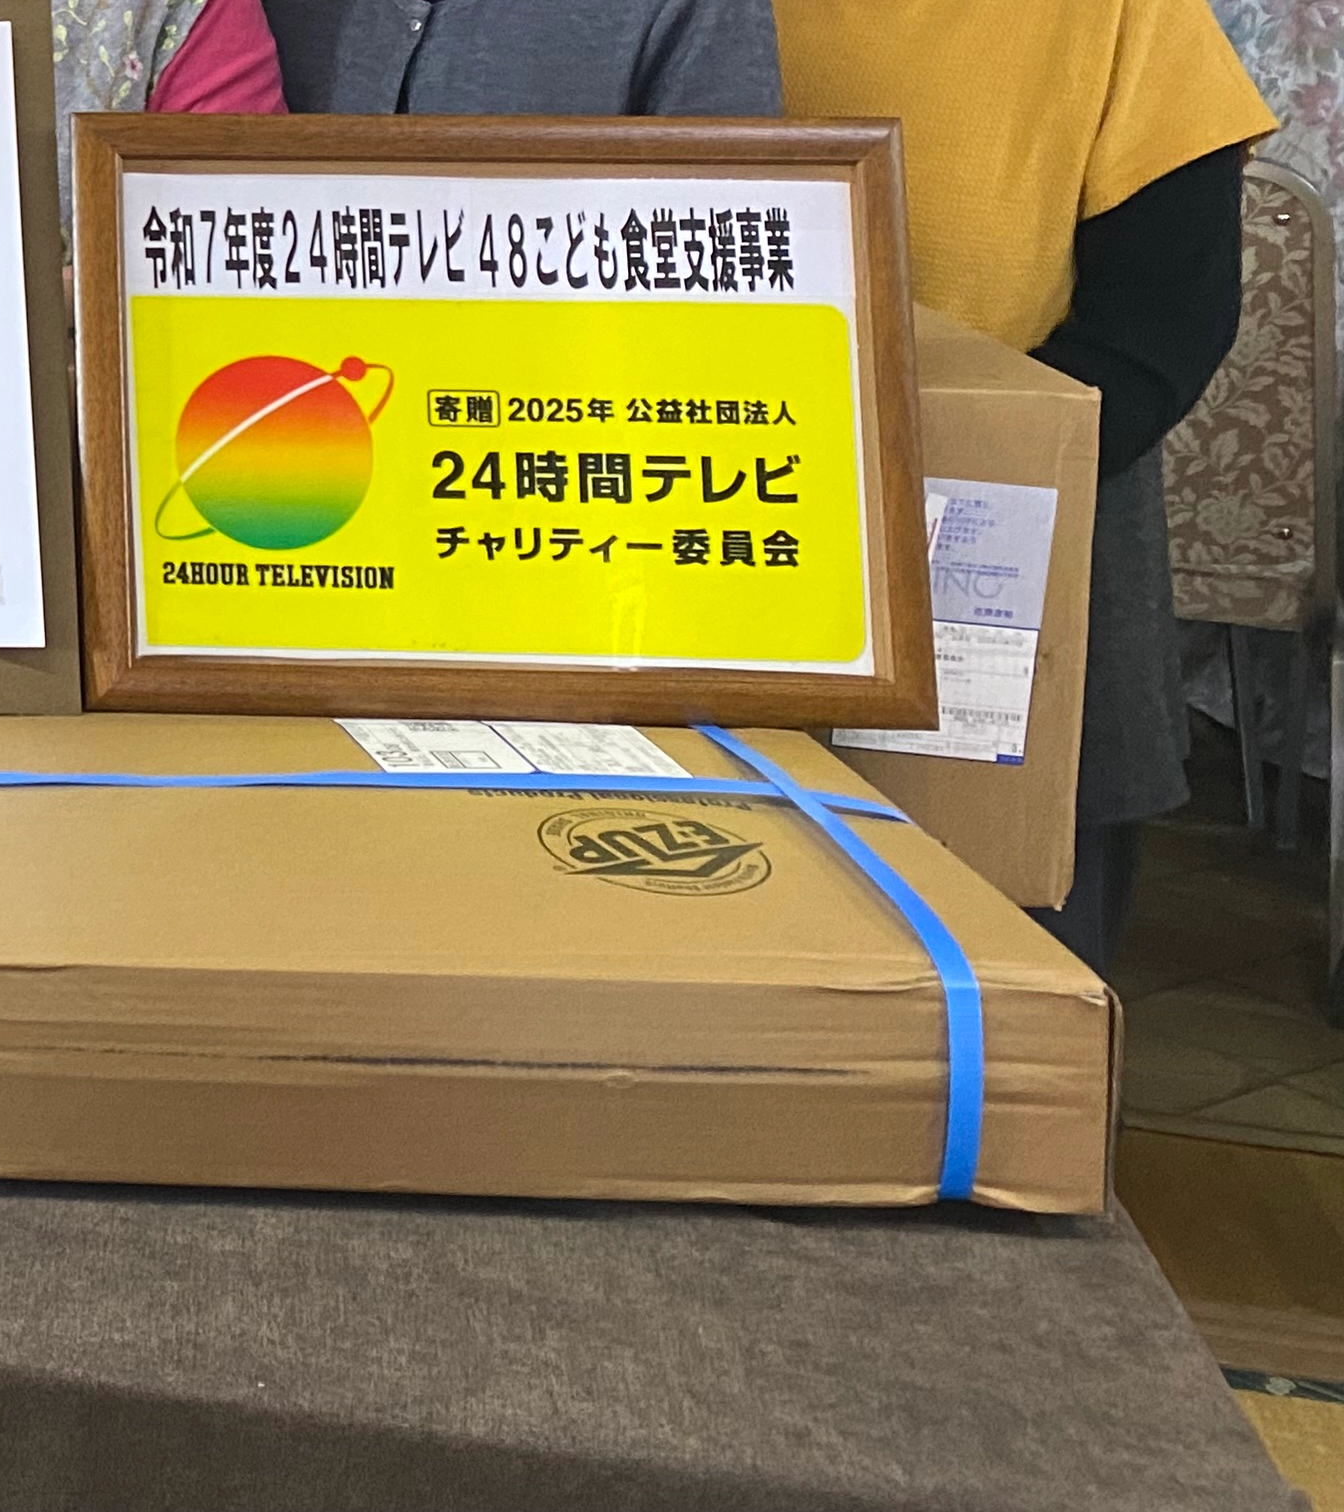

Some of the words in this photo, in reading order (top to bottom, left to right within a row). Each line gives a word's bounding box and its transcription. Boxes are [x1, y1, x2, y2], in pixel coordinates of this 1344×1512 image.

[434, 395, 495, 424] 寄贈
[507, 397, 615, 424] 2025年
[625, 397, 798, 426] 公益社団法人
[431, 449, 802, 506] 24時間テレビ
[435, 525, 801, 569] チャリティー委員会
[162, 561, 250, 587] 24HOUR
[255, 563, 396, 591] TELEVISION
